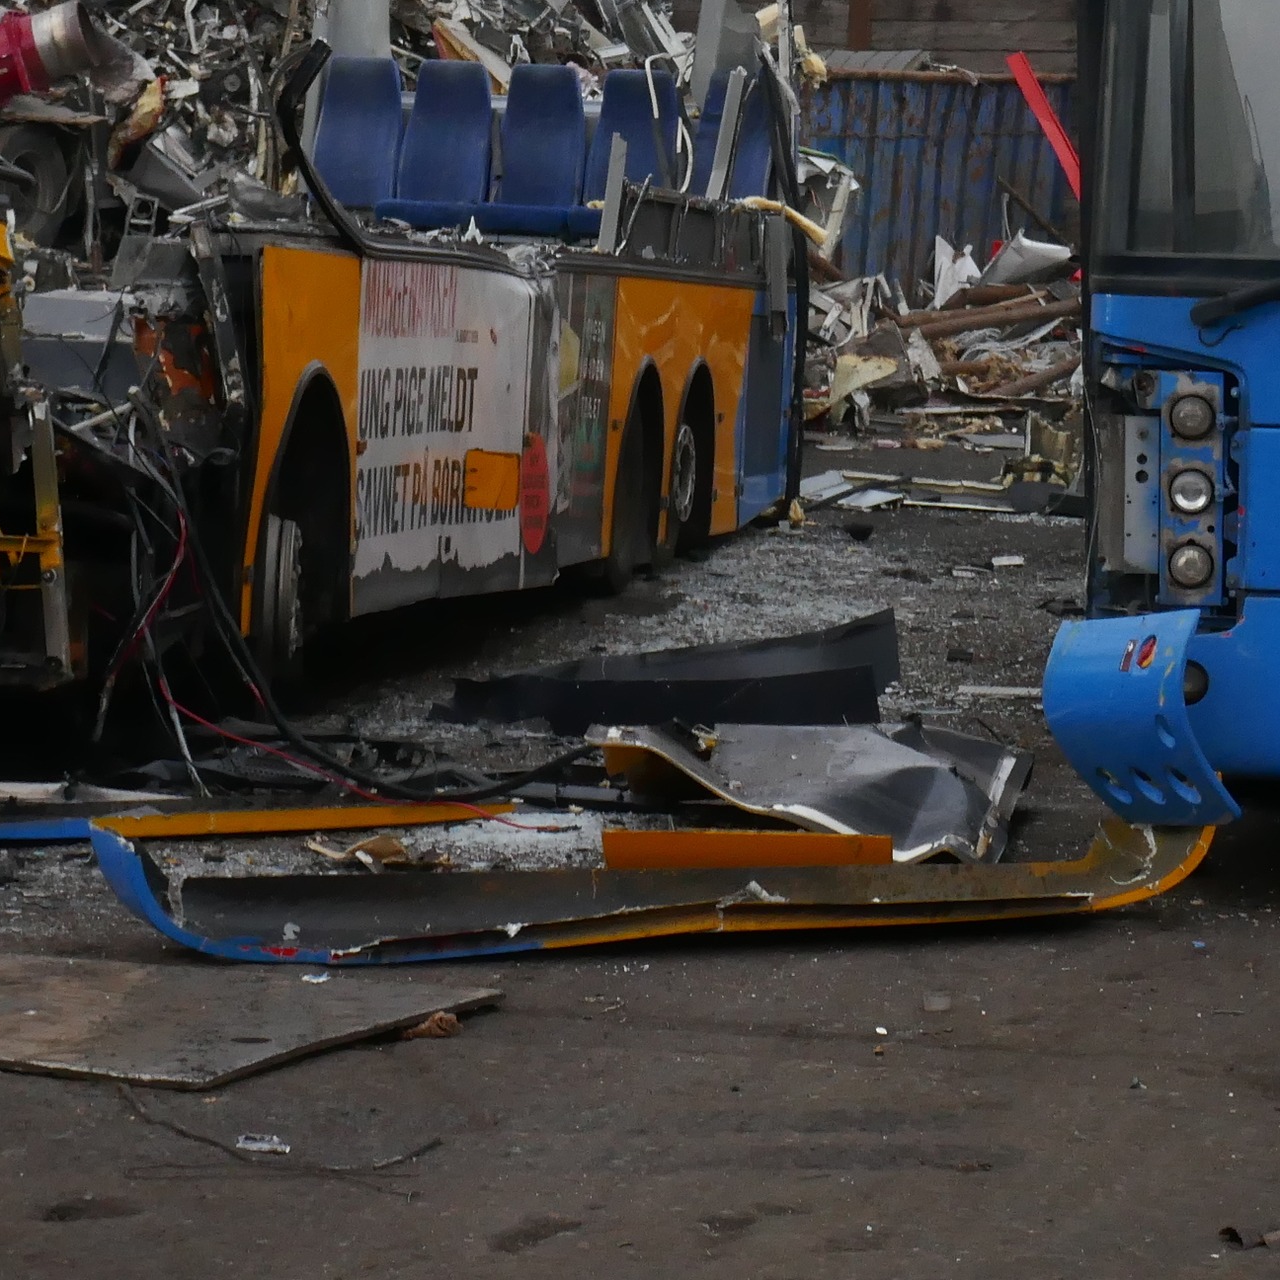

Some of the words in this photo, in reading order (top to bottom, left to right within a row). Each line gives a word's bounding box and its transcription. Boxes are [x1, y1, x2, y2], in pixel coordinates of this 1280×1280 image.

[358, 366, 392, 440] UNG
[392, 366, 426, 437] PIGE
[426, 365, 479, 433] MELDT
[355, 463, 410, 540] SAVNET
